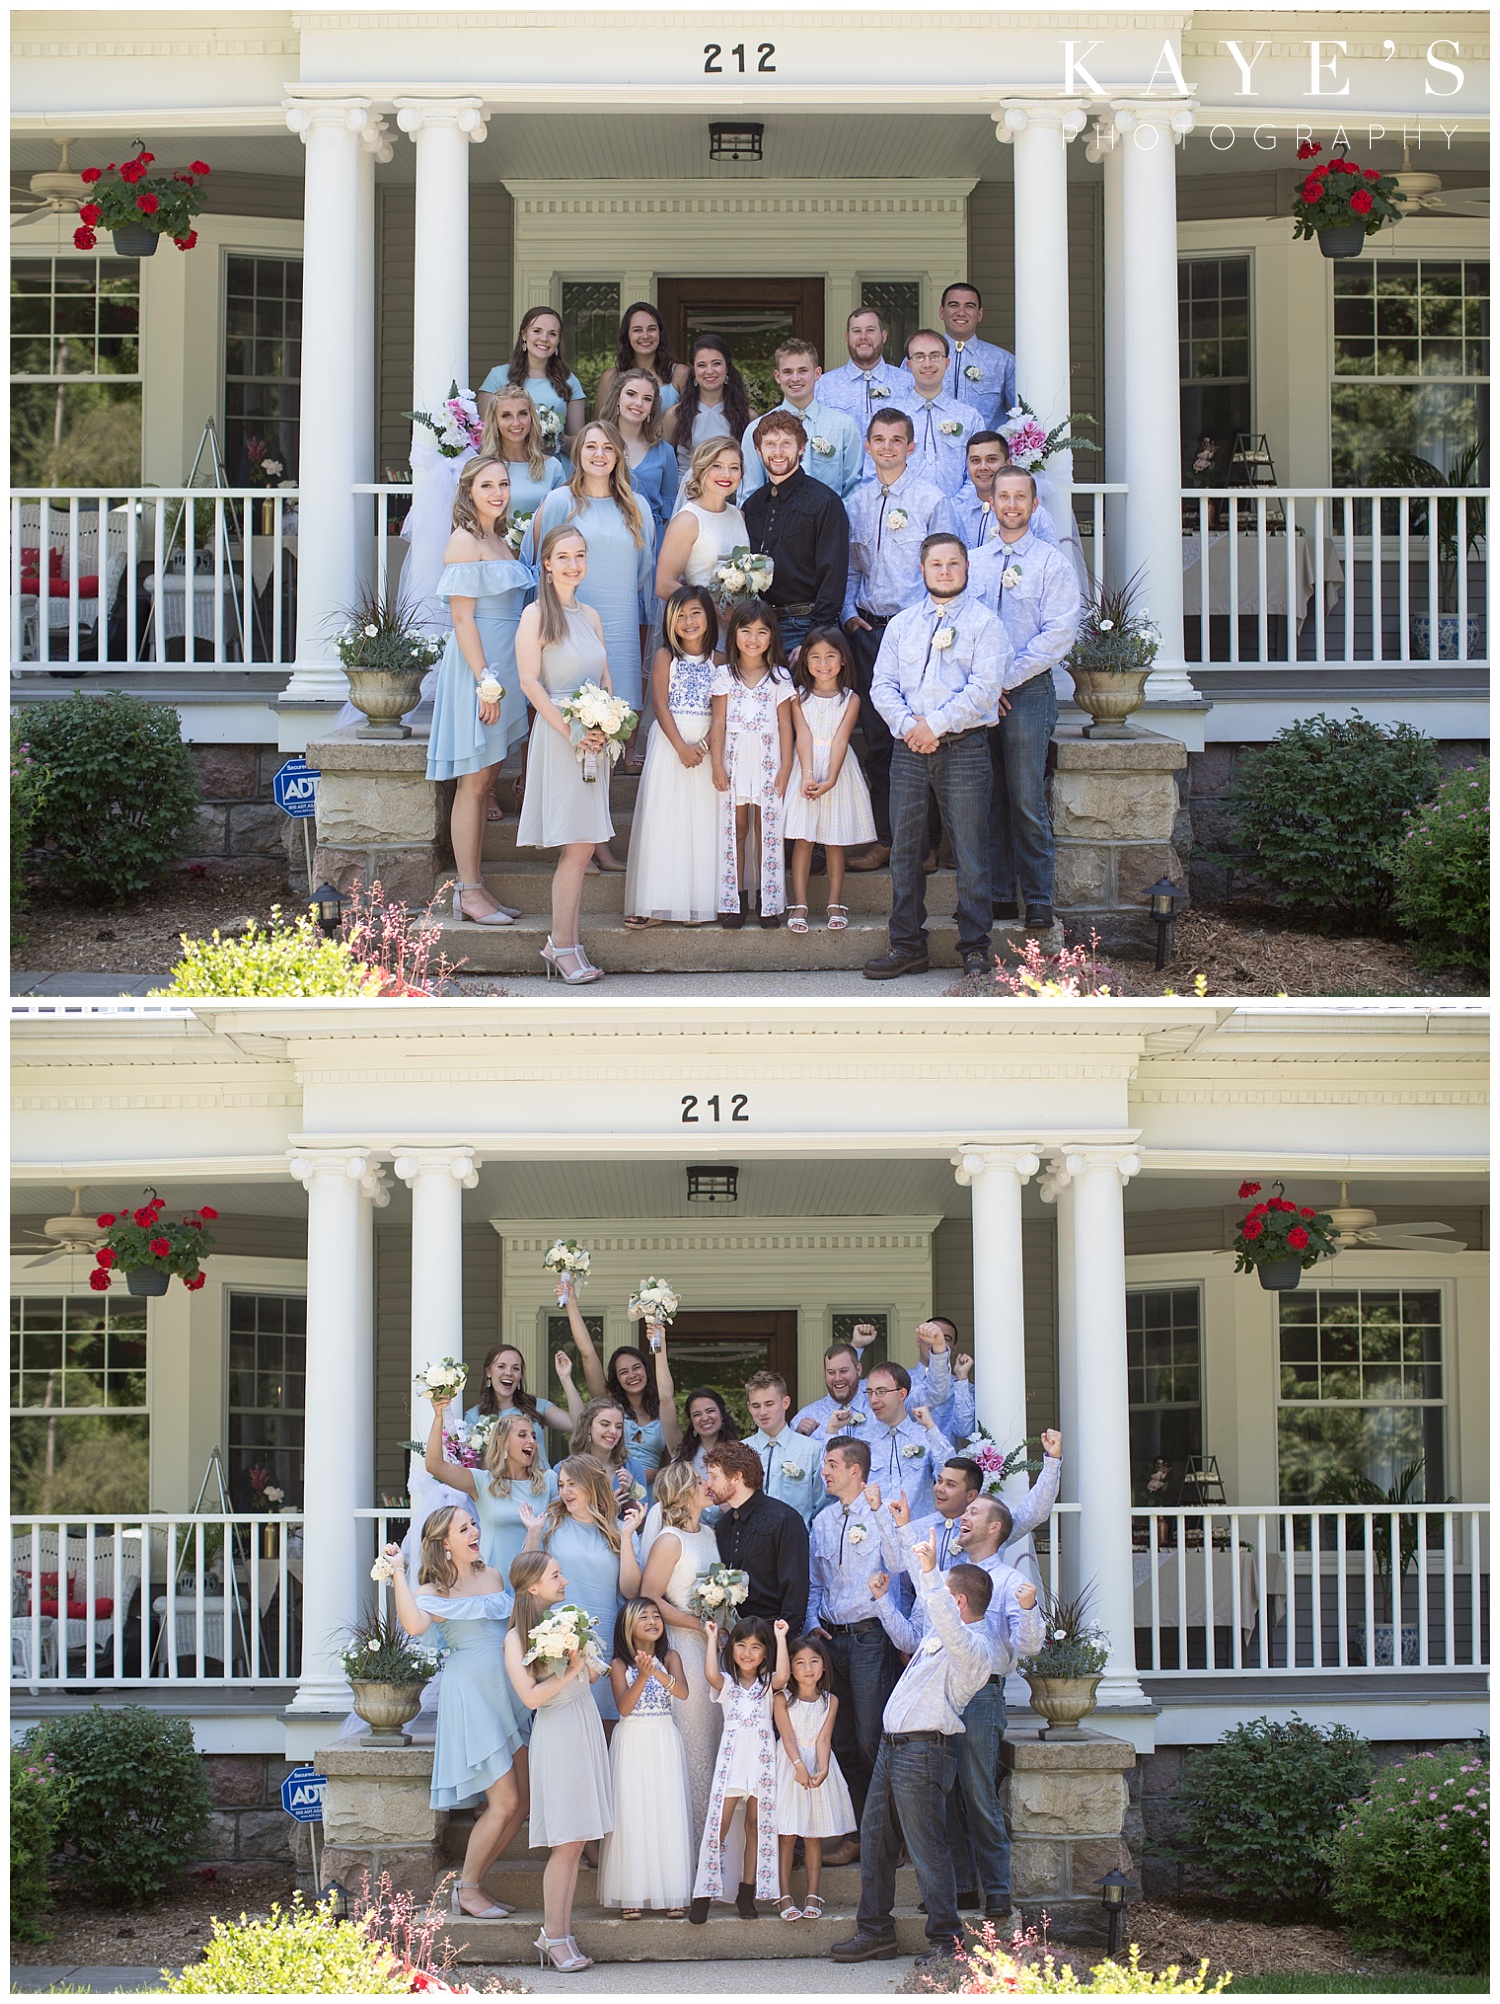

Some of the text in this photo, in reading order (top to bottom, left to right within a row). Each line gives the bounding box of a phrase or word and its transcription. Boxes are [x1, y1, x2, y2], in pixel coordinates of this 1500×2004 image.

[704, 43, 776, 73] 212
[284, 777, 322, 800] ADT
[681, 1094, 749, 1122] 212
[292, 1784, 327, 1805] ADT
